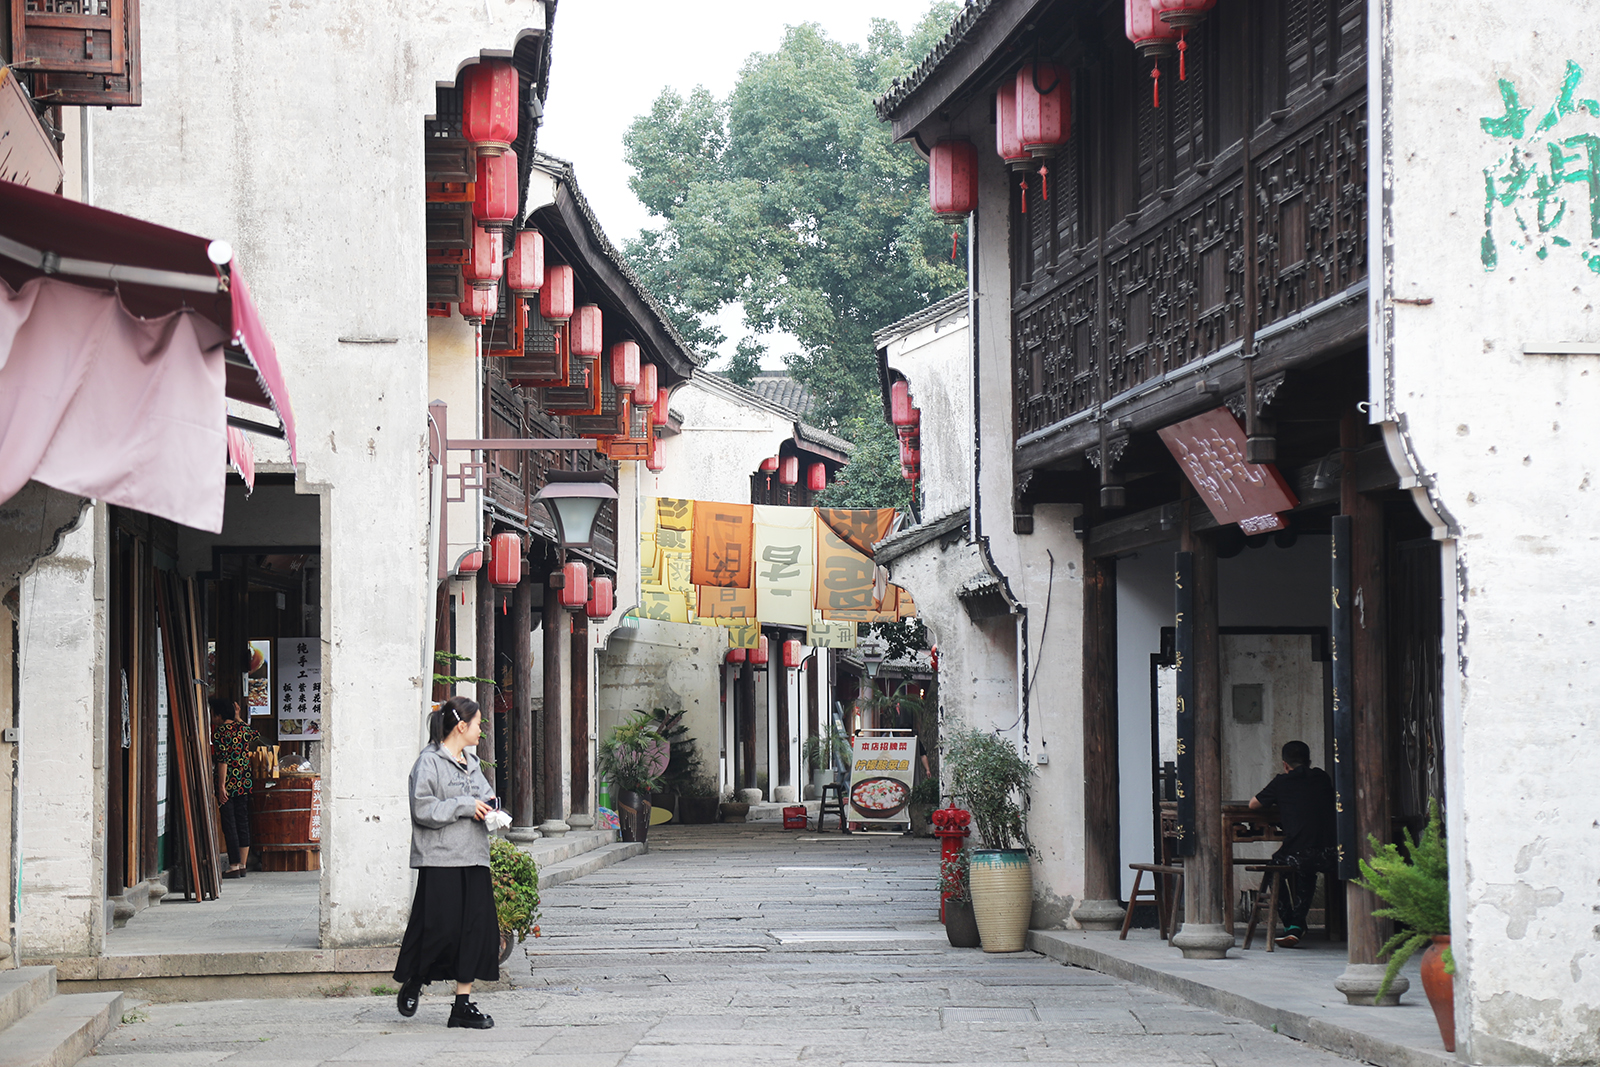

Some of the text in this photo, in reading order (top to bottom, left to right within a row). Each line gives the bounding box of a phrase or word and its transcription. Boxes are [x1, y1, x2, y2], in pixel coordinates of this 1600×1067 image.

[297, 642, 309, 679] 纯手工
[283, 682, 293, 714] 板栗饼
[298, 682, 308, 714] 紫米饼
[861, 742, 907, 751] 本店招牌菜
[855, 759, 909, 771] 柠檬酸菜鱼
